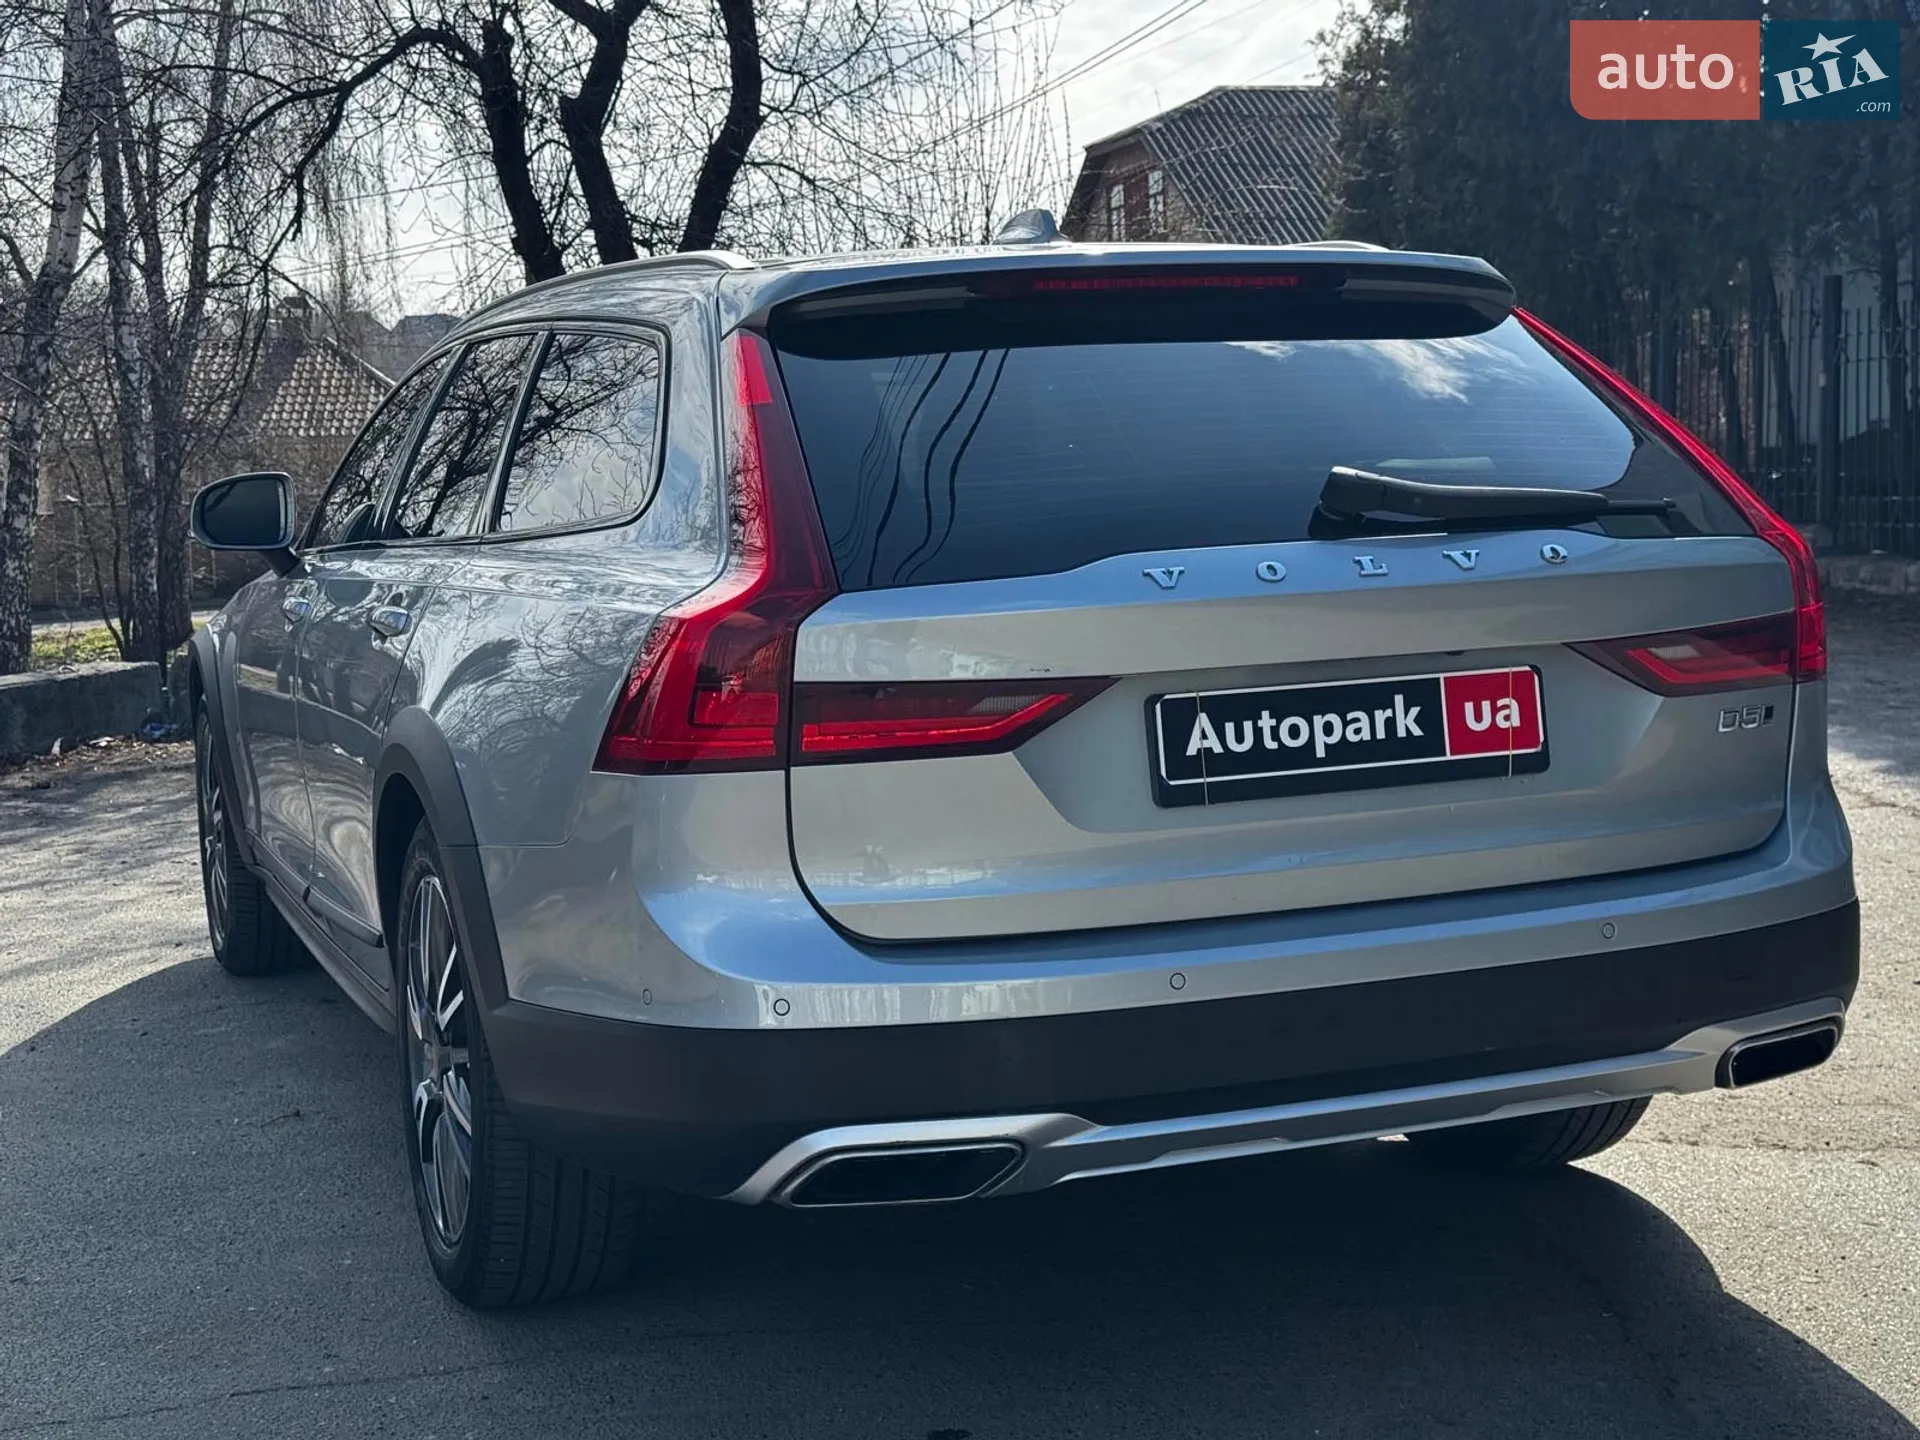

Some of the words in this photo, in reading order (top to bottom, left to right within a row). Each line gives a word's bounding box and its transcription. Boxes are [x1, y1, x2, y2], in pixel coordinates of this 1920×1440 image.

[1143, 543, 1569, 590] VOLVO
[1185, 693, 1424, 759] Autopark
[1463, 696, 1522, 733] ua
